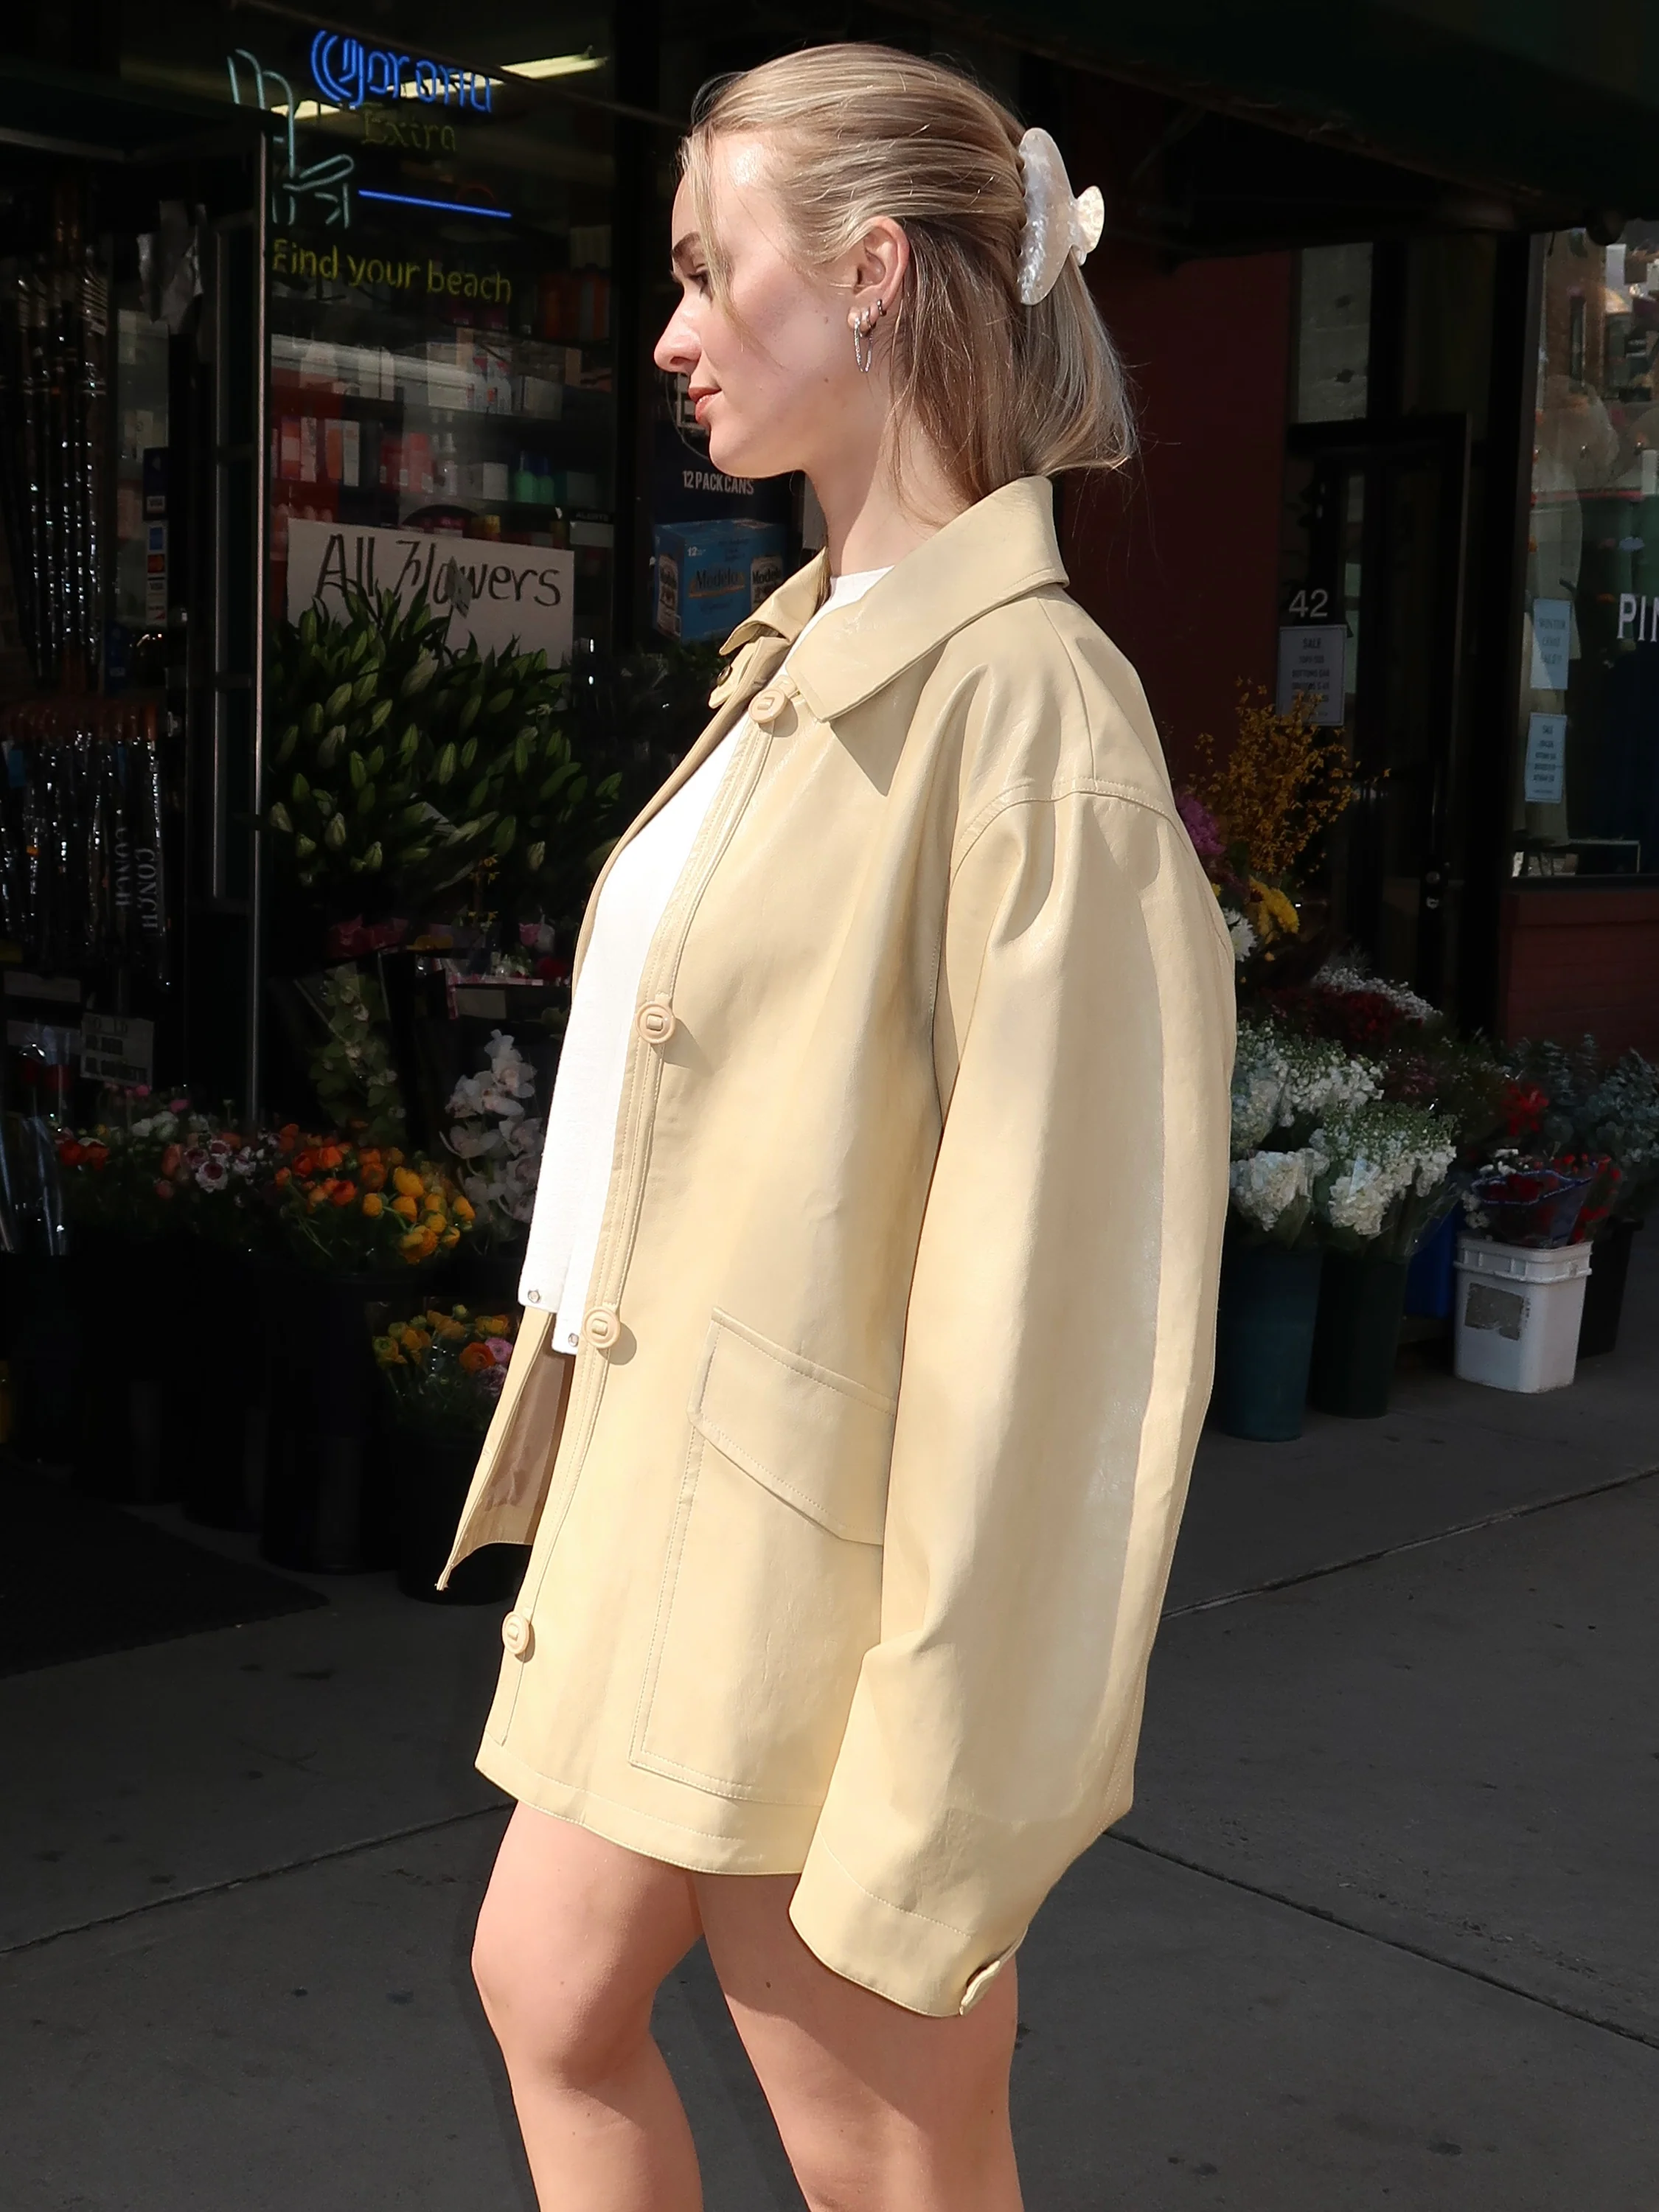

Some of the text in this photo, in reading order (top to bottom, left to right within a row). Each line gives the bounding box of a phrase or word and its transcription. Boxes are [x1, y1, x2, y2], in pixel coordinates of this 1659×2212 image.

[310, 29, 492, 113] Corona
[361, 102, 456, 152] Extra
[271, 237, 512, 305] Find your beach
[682, 470, 755, 495] 12 PACK CANS
[315, 533, 375, 598] All
[1288, 588, 1329, 619] 42
[135, 848, 159, 928] CONCH
